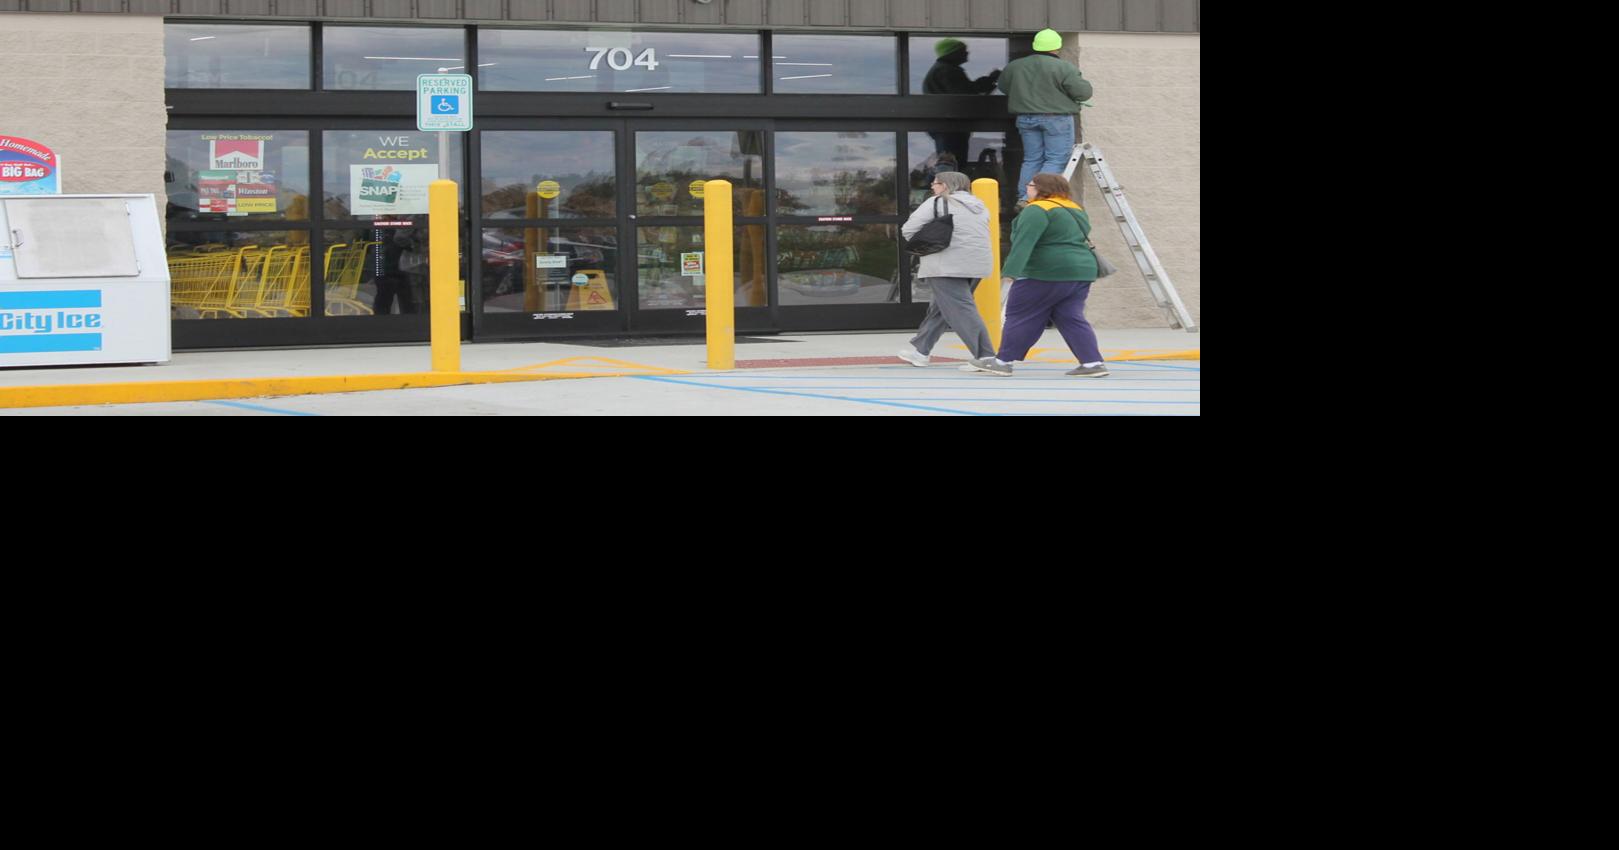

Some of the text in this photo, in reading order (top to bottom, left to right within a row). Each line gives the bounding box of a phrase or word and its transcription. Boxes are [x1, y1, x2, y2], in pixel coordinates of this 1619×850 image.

[585, 46, 660, 71] 704
[422, 79, 468, 87] RESERVED
[379, 135, 410, 147] WE
[0, 139, 51, 160] Homemade
[363, 147, 428, 160] Accept
[215, 156, 259, 169] Marlboro
[2, 166, 45, 177] BIG BAG
[360, 185, 398, 197] SNAP
[0, 311, 101, 334] City Ice
